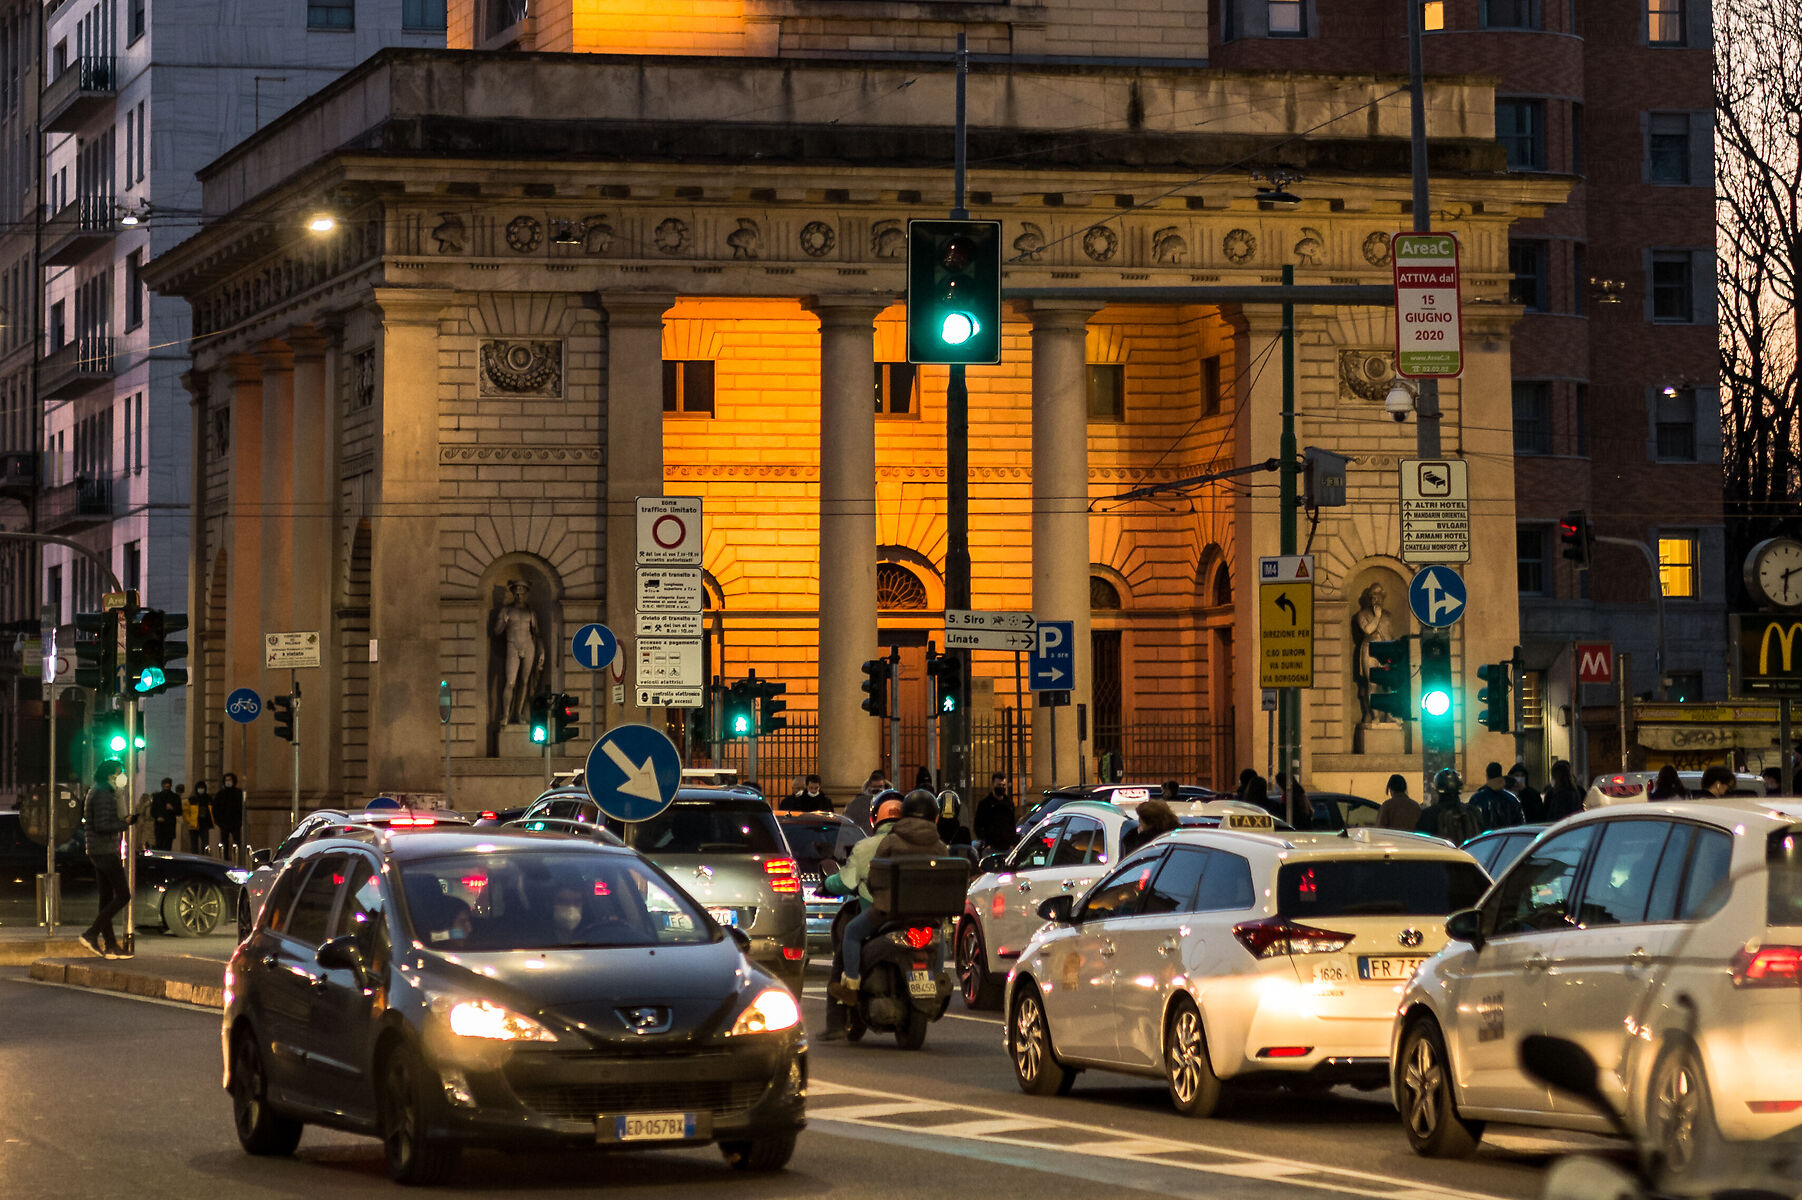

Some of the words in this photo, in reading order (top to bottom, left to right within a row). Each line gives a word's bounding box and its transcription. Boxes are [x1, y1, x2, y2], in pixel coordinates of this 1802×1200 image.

[1401, 240, 1450, 255] AreaC
[1400, 273, 1437, 283] ATTIVA
[1439, 273, 1454, 283] dal
[1421, 294, 1435, 305] 15
[1405, 312, 1452, 323] GIUGNO
[1415, 330, 1444, 340] 2020
[1264, 564, 1277, 576] M4
[948, 614, 959, 624] S.
[964, 615, 985, 625] Siro
[947, 634, 980, 644] Linate
[1263, 630, 1295, 638] DIREZIONE
[1298, 630, 1310, 638] PER
[1039, 626, 1063, 659] P
[1281, 648, 1306, 657] EUROPA
[1274, 674, 1309, 682] BORGOGNA
[1231, 816, 1270, 828] TAXI
[1320, 967, 1343, 981] 1626
[1371, 960, 1391, 977] FR
